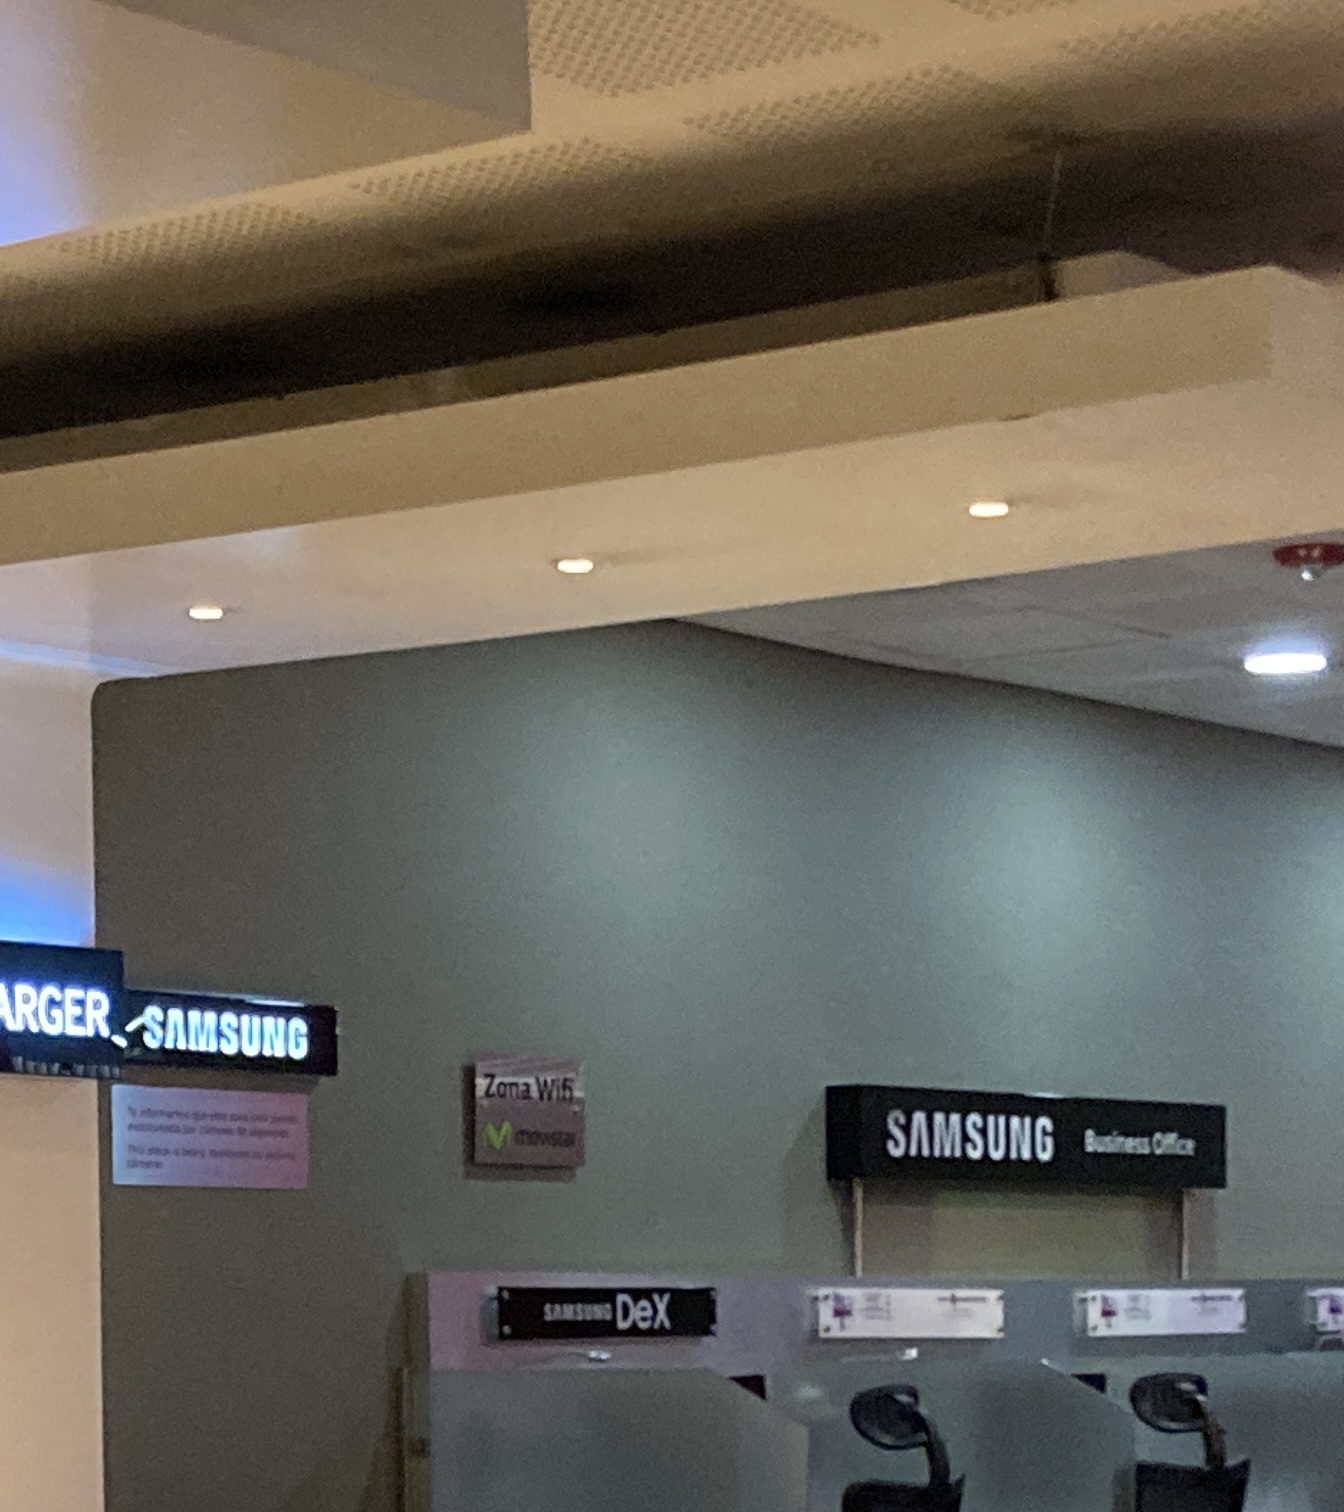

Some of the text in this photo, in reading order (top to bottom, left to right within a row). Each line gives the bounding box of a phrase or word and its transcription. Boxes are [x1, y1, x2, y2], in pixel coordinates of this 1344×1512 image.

[141, 1004, 308, 1059] SAMSUNG
[483, 1073, 532, 1100] Zona
[886, 1110, 1055, 1163] SAMSUNG
[1084, 1128, 1196, 1156] Business Office
[543, 1292, 671, 1330] SAMSUNG DeX
